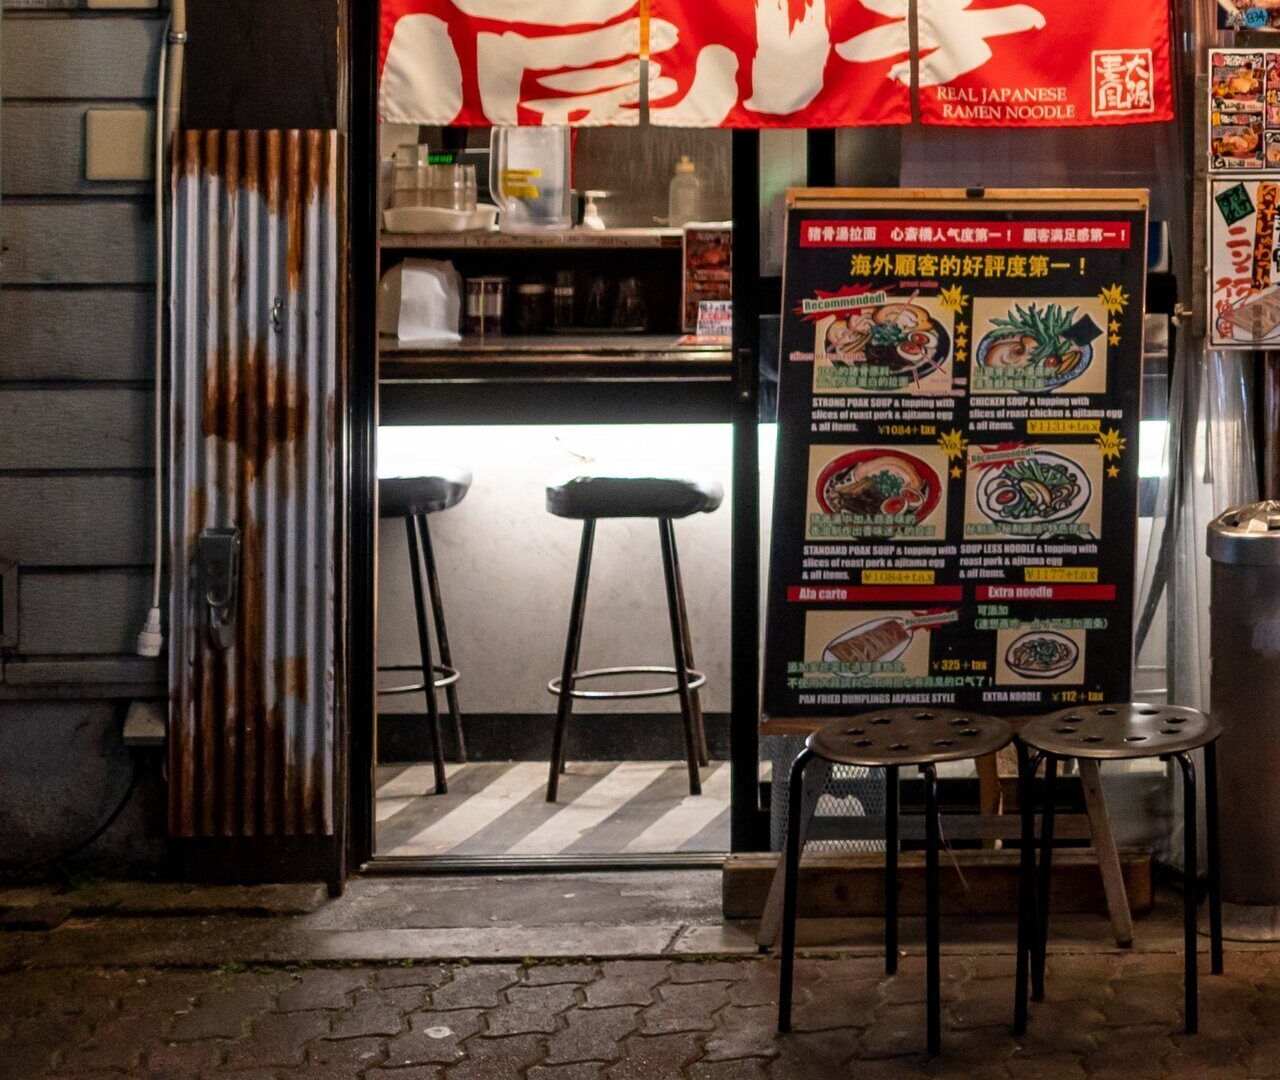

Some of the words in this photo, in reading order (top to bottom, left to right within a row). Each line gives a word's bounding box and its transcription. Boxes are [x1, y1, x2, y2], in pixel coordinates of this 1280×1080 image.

[937, 85, 978, 102] REAL
[981, 86, 1067, 104] JAPANESE
[943, 103, 1001, 119] RAMEN
[1006, 104, 1076, 120] NOODLE
[803, 292, 887, 312] Recommended!
[812, 397, 846, 408] STRONG
[870, 397, 892, 408] SOUP
[901, 397, 934, 408] topping
[936, 397, 955, 408] with
[969, 396, 1005, 408] CHICKEN
[1007, 396, 1028, 408] SOUP
[1037, 396, 1069, 408] topping
[1071, 396, 1090, 408] with
[812, 410, 838, 421] slices
[839, 410, 849, 421] of
[850, 410, 872, 421] roast
[874, 410, 893, 421] pork
[936, 410, 953, 421] egg
[969, 409, 995, 419] slices
[996, 409, 1005, 419] of
[1006, 409, 1028, 419] roast
[1029, 409, 1064, 419] chicken
[1106, 409, 1123, 419] egg
[818, 422, 831, 432] all
[976, 421, 988, 430] all
[803, 545, 847, 556] STANDARD
[872, 545, 895, 556] SOUP
[938, 545, 957, 556] with
[960, 543, 982, 555] SOUP
[983, 543, 1002, 555] LESS
[1004, 543, 1035, 555] NOODLE
[1078, 543, 1098, 555] with
[830, 558, 840, 568] of
[841, 558, 864, 568] roast
[865, 558, 886, 568] pork
[929, 558, 945, 568] egg
[959, 556, 982, 567] roast
[983, 556, 1003, 567] pork
[1046, 556, 1063, 567] egg
[810, 570, 822, 580] all
[966, 569, 978, 579] all
[988, 586, 1014, 599] Extra
[1016, 586, 1053, 599] noodle
[817, 693, 841, 704] FRIED
[892, 693, 930, 704] JAPANESE
[932, 693, 955, 704] STYLE
[982, 691, 1008, 702] EXTRA
[1009, 691, 1041, 702] NOODLE
